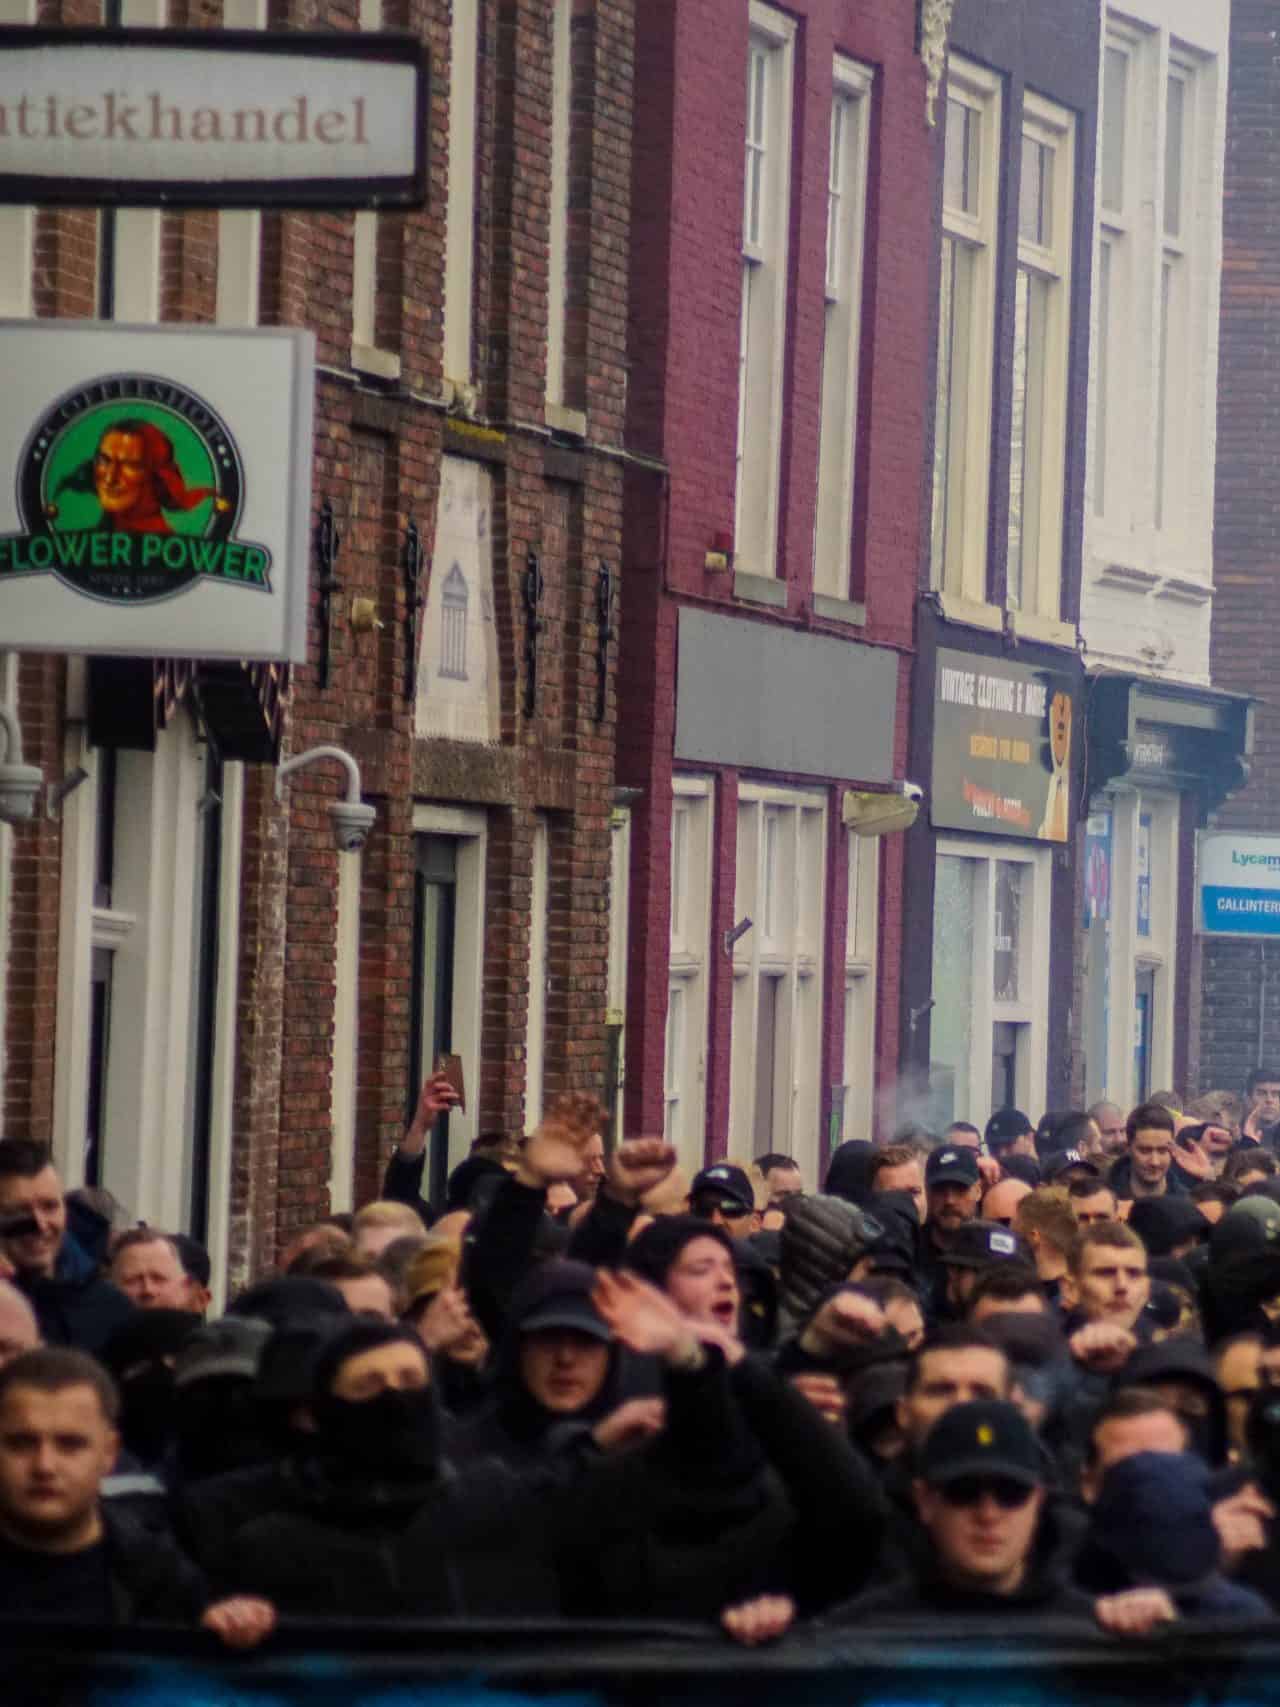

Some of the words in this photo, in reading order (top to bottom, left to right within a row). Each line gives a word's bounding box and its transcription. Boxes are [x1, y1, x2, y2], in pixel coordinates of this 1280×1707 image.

[0, 90, 370, 145] tiekhandel
[142, 534, 266, 581] POWER
[941, 667, 975, 706] VINTAGE
